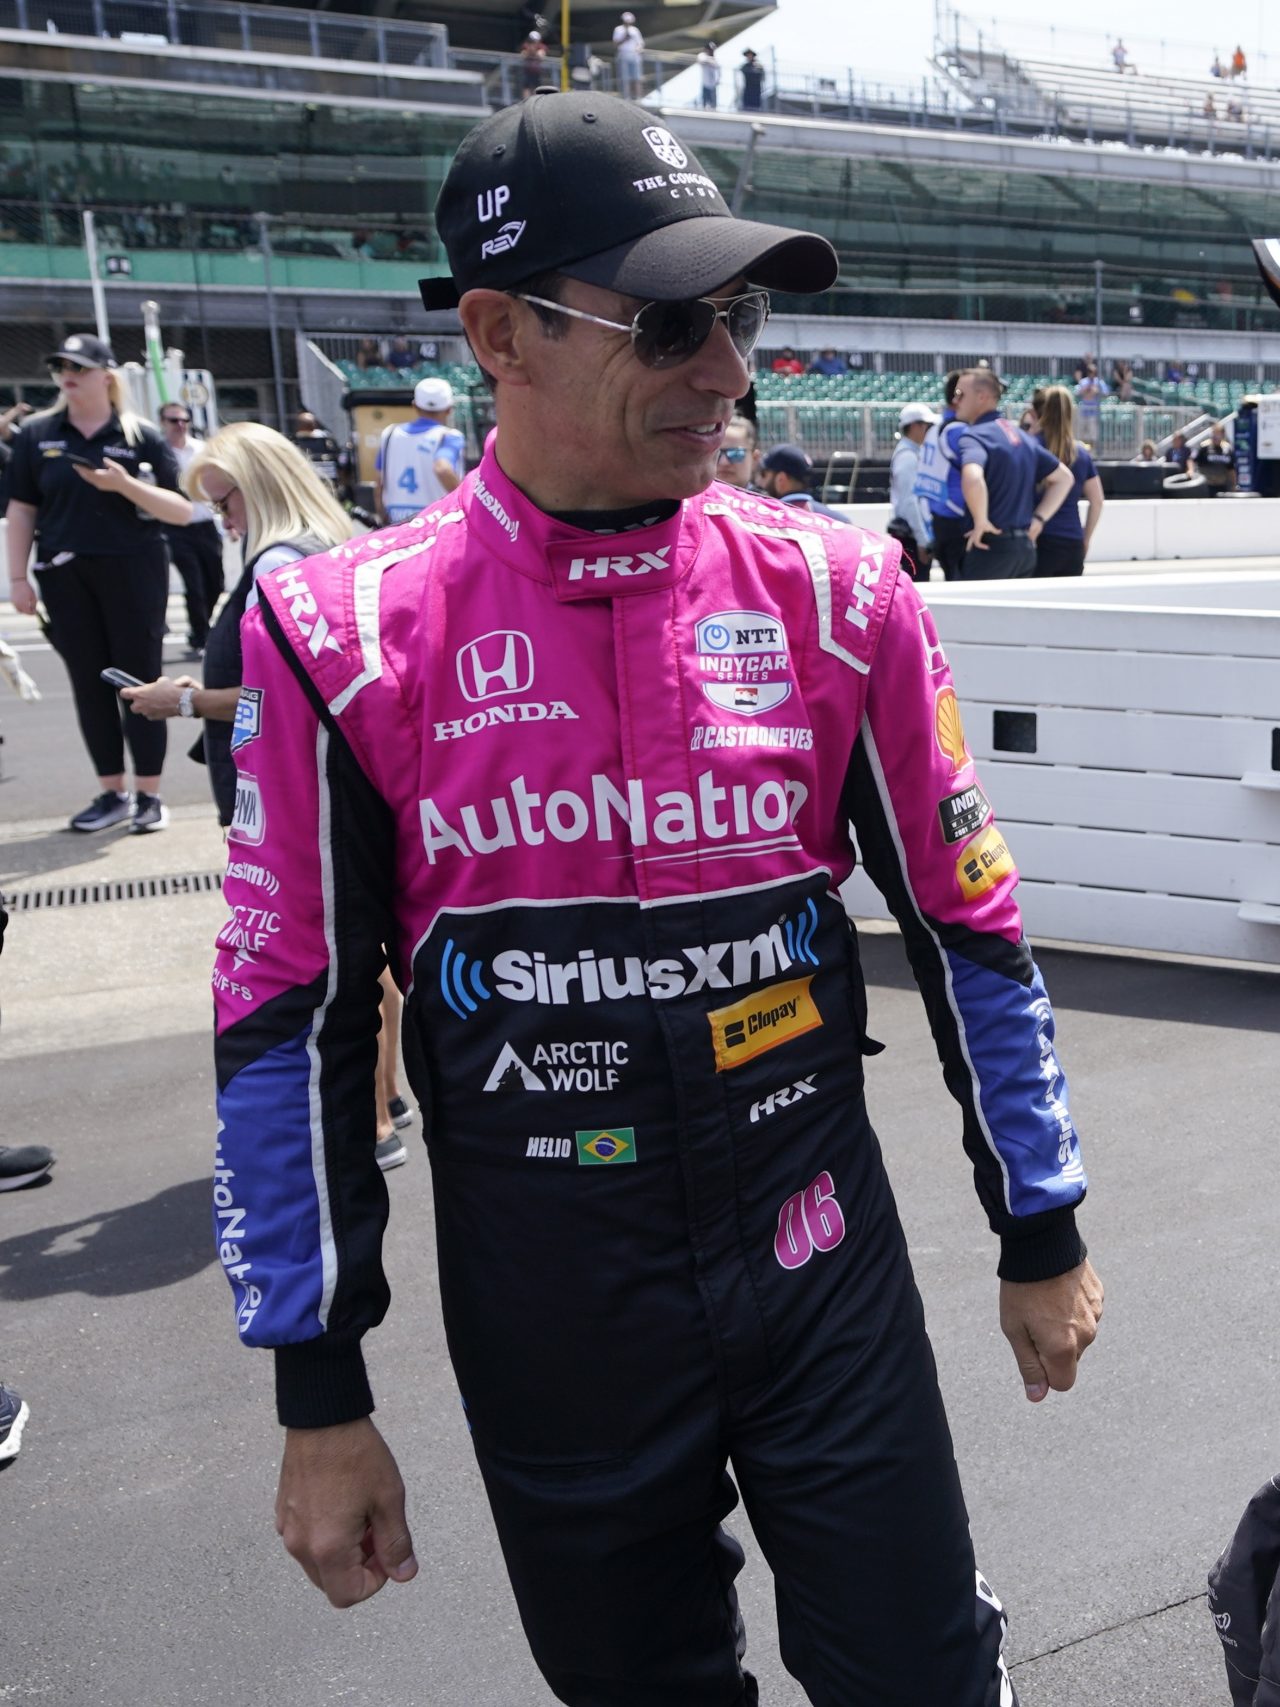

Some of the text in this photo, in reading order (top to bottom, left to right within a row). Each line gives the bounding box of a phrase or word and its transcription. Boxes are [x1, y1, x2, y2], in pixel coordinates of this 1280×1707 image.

[632, 174, 667, 193] THE
[478, 185, 510, 222] UP
[481, 220, 526, 260] REV
[397, 466, 419, 494] 4
[567, 545, 672, 581] HRX
[275, 569, 343, 659] HRX
[735, 628, 778, 645] NTT
[699, 654, 789, 672] INDYCAR
[717, 670, 769, 682] SERIES
[433, 701, 579, 742] HONDA
[420, 769, 809, 865] AutoNation
[746, 997, 799, 1037] Clopay
[532, 1040, 629, 1065] ARCTIC
[547, 1068, 621, 1092] WOLF
[748, 1073, 819, 1123] HRX
[526, 1136, 572, 1158] HELIO
[773, 1170, 846, 1270] 06
